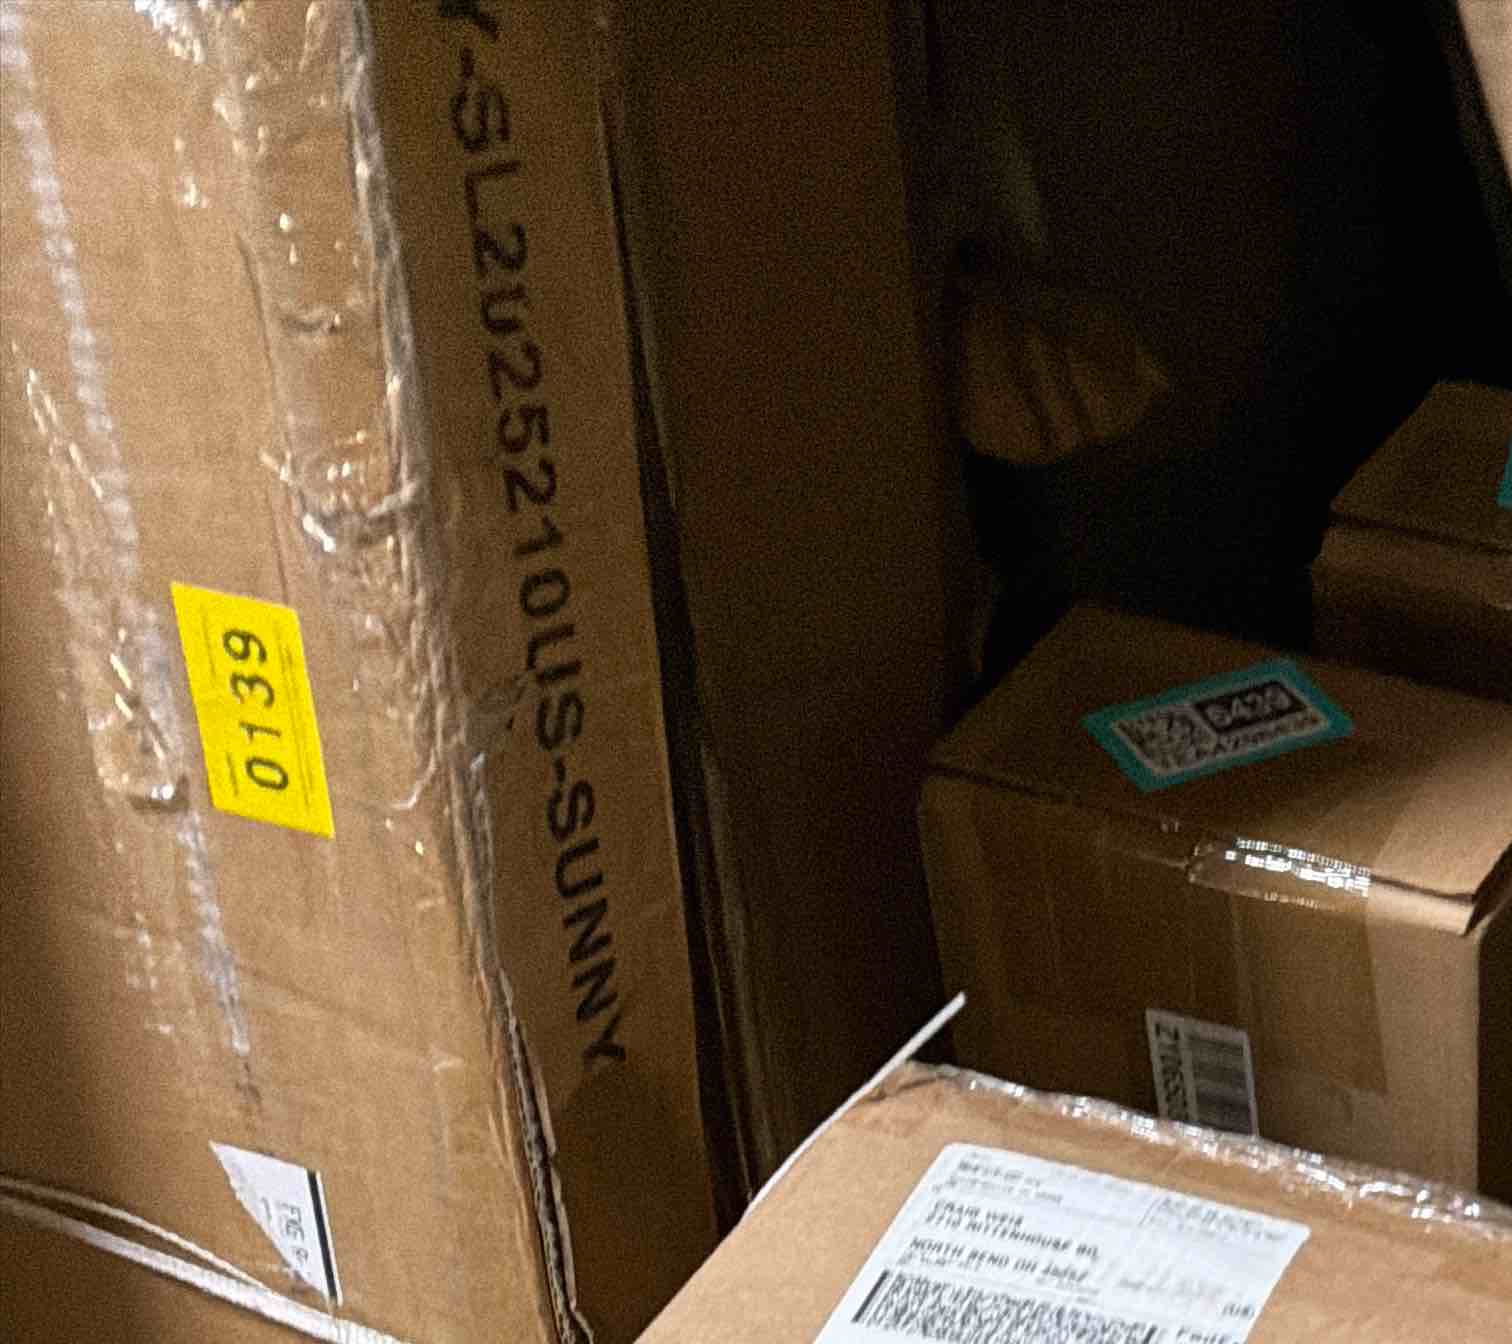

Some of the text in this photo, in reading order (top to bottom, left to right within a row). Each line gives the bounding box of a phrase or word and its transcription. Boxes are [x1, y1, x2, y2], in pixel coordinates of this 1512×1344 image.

[222, 628, 289, 790] 0139
[910, 1236, 966, 1258] NORTH
[968, 1247, 1009, 1268] BEND
[1013, 1257, 1039, 1273] OH
